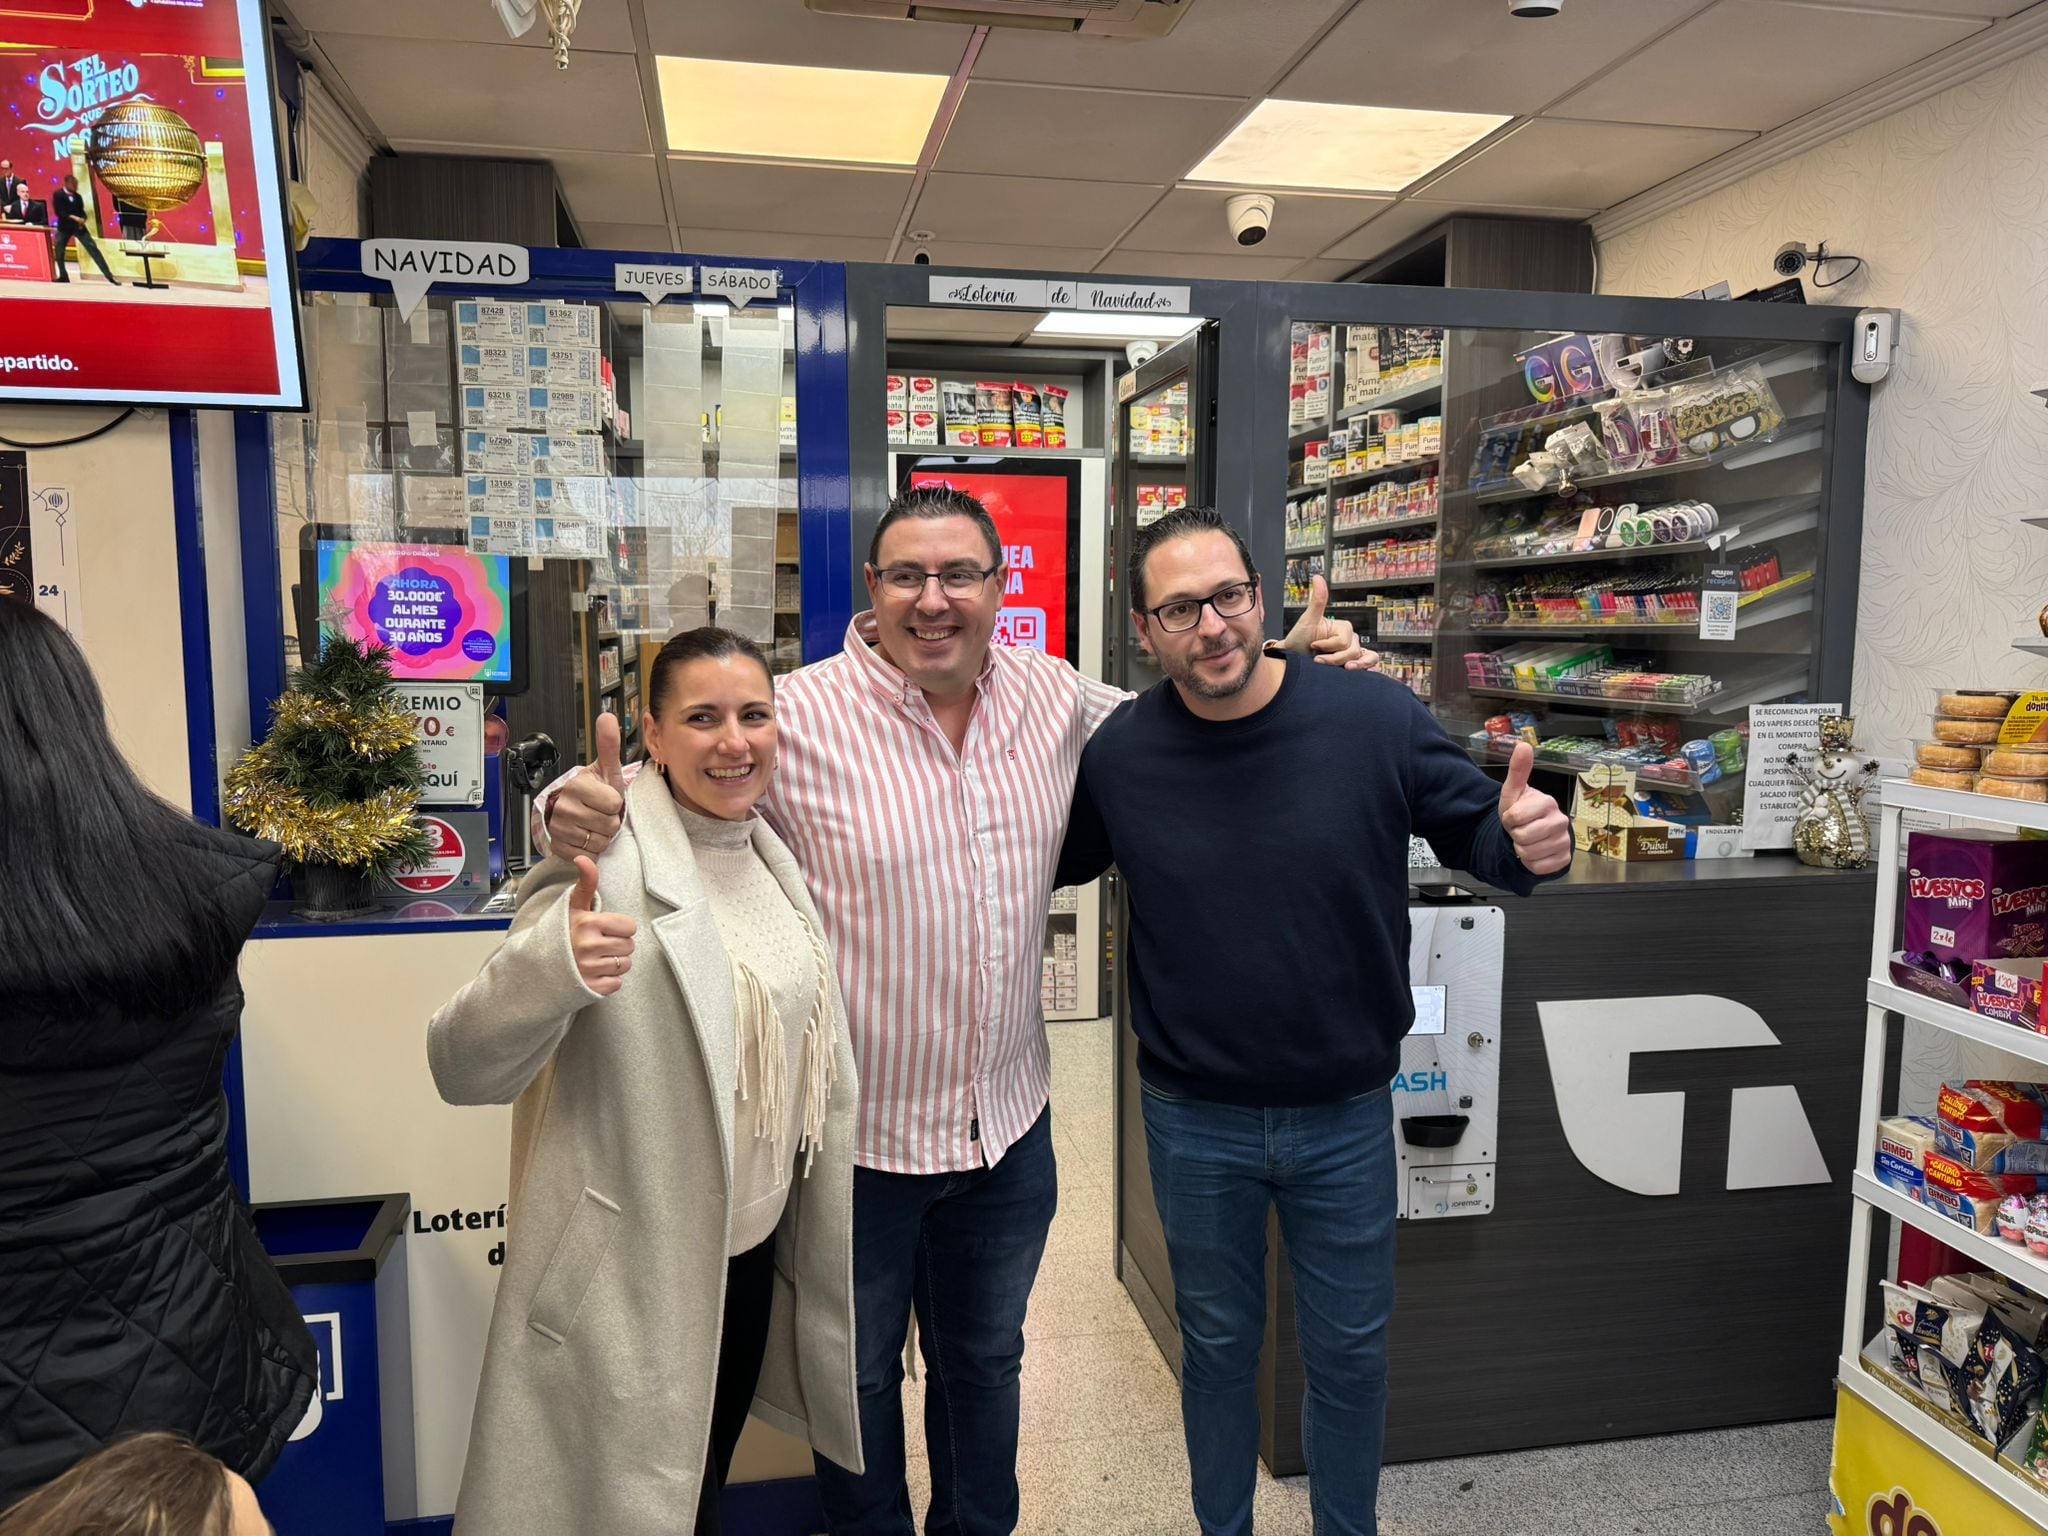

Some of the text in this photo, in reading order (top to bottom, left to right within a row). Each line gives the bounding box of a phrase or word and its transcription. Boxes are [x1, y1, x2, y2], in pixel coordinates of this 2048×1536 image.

[75, 54, 106, 81] EL
[37, 60, 139, 120] SORTEO
[81, 108, 105, 125] QUE
[374, 248, 517, 277] NAVIDAD
[623, 270, 685, 286] JUEVES
[707, 270, 771, 290] SÁBADO
[1051, 286, 1071, 305] de
[1090, 289, 1156, 310] Navidad
[1352, 332, 1378, 342] mata
[0, 354, 79, 373] partido.
[911, 394, 936, 403] Fumar
[914, 403, 934, 411] mata
[911, 429, 936, 437] Fumar
[914, 437, 934, 445] mata
[1305, 463, 1328, 473] Fumar
[1307, 472, 1325, 481] mata
[392, 579, 440, 589] AHORA
[1706, 578, 1736, 586] recogida
[39, 584, 59, 596] 24
[392, 605, 438, 616] AL MES
[385, 618, 446, 630] DURANTE
[389, 629, 443, 643] 30 AÑOS
[1755, 707, 1836, 716] SE RECOMIENDA PROBAR
[1753, 719, 1820, 728] LOS VAPERS DESECH
[445, 726, 455, 737] €
[1757, 732, 1766, 740] EN
[1775, 731, 1813, 739] MOMENTO
[1778, 743, 1808, 751] COMPRA
[1763, 756, 1774, 764] NO
[427, 770, 458, 788] QUÍ
[1759, 791, 1787, 799] SACADO
[1640, 840, 1669, 851] Dubai
[1910, 876, 1986, 900] HUESITOS
[1947, 897, 1974, 910] Mini
[1992, 884, 2048, 916] HUESITO
[2025, 902, 2046, 917] Mini
[1976, 992, 2026, 1013] HUESITOS
[1392, 1072, 1447, 1092] ASH
[1938, 1120, 1963, 1141] BIMBO
[1881, 1140, 1913, 1161] BIMBO
[1880, 1156, 1890, 1166] Sin
[1890, 1160, 1914, 1177] Corteza
[1927, 1186, 1959, 1208] BIMBO
